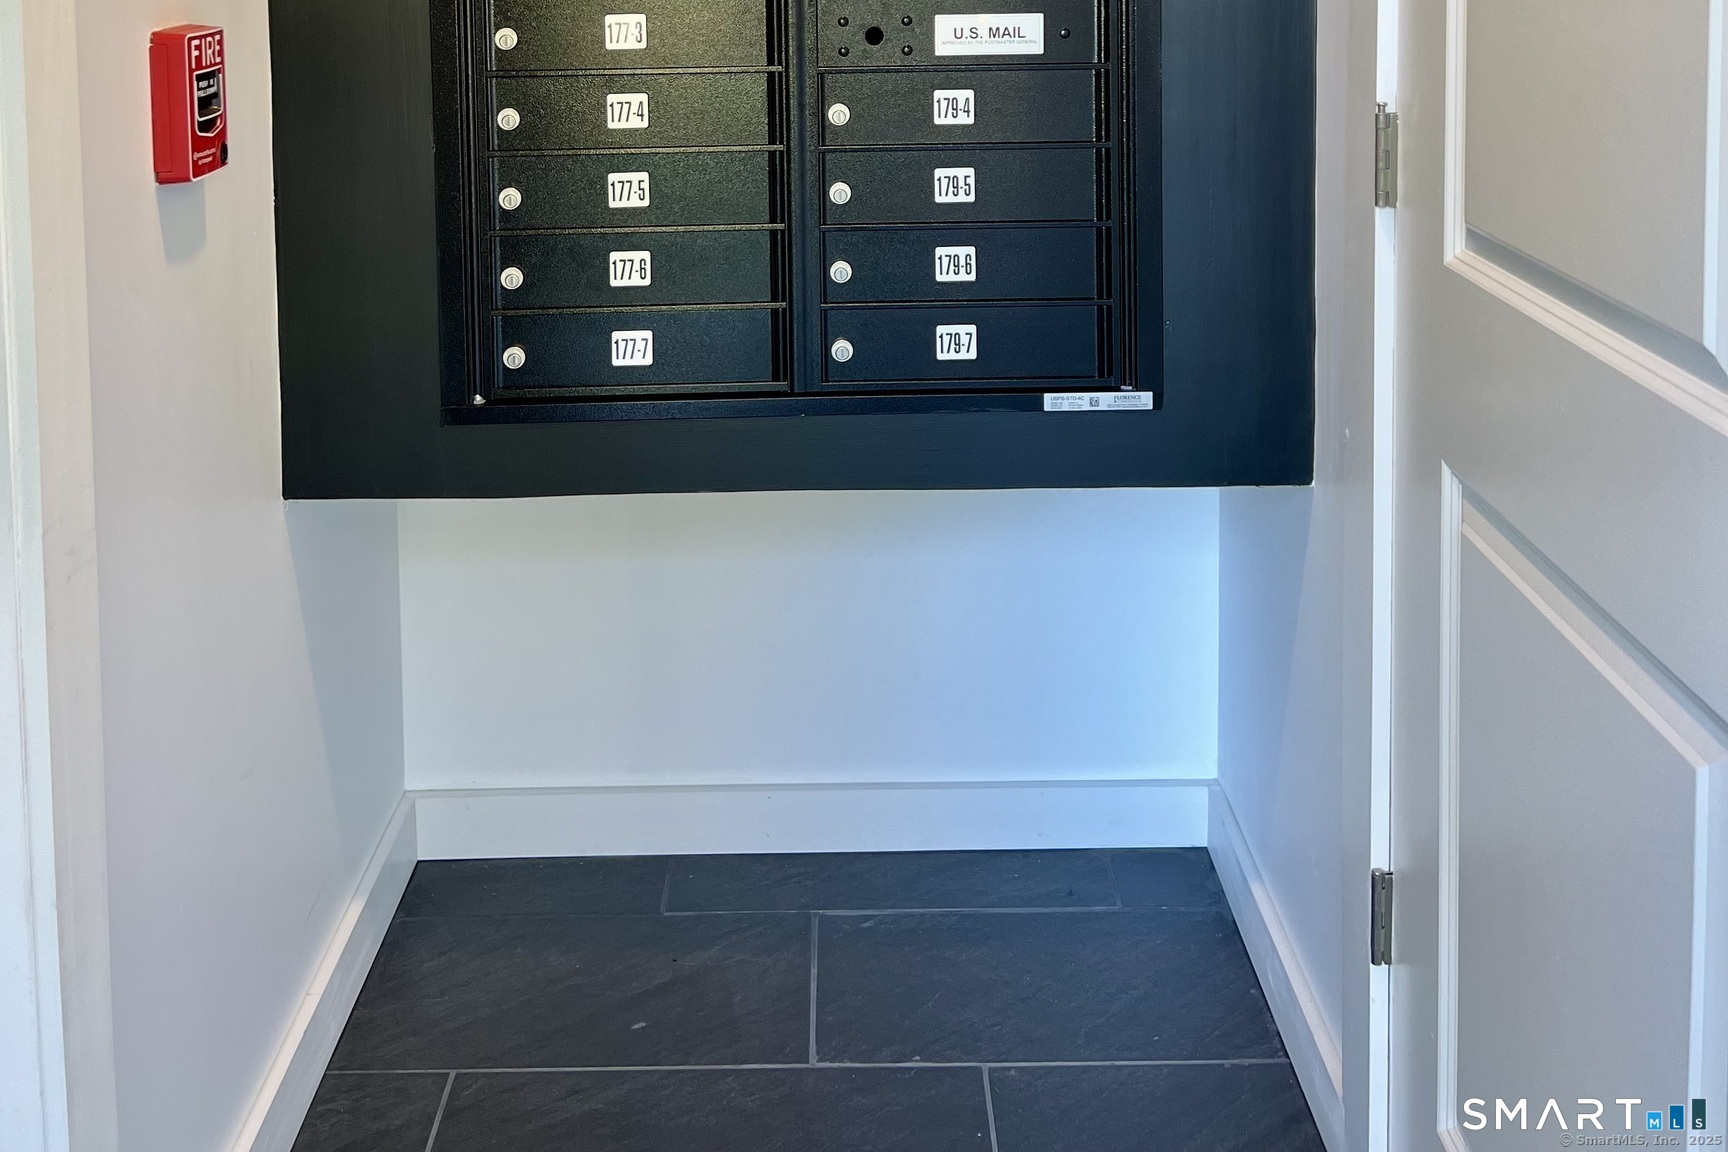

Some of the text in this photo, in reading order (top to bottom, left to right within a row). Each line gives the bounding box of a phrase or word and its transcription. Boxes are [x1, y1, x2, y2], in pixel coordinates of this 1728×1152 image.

[607, 22, 643, 44] 177-3
[953, 26, 1026, 39] U.S. MAIL
[191, 34, 221, 69] FIRE
[609, 101, 644, 123] 177-4
[936, 97, 971, 119] 179-4
[610, 180, 646, 202] 177-5
[937, 175, 971, 197] 179-5
[612, 259, 647, 281] 177-6
[938, 254, 972, 276] 179-6
[614, 338, 648, 360] 177-7
[938, 332, 973, 354] 179-7
